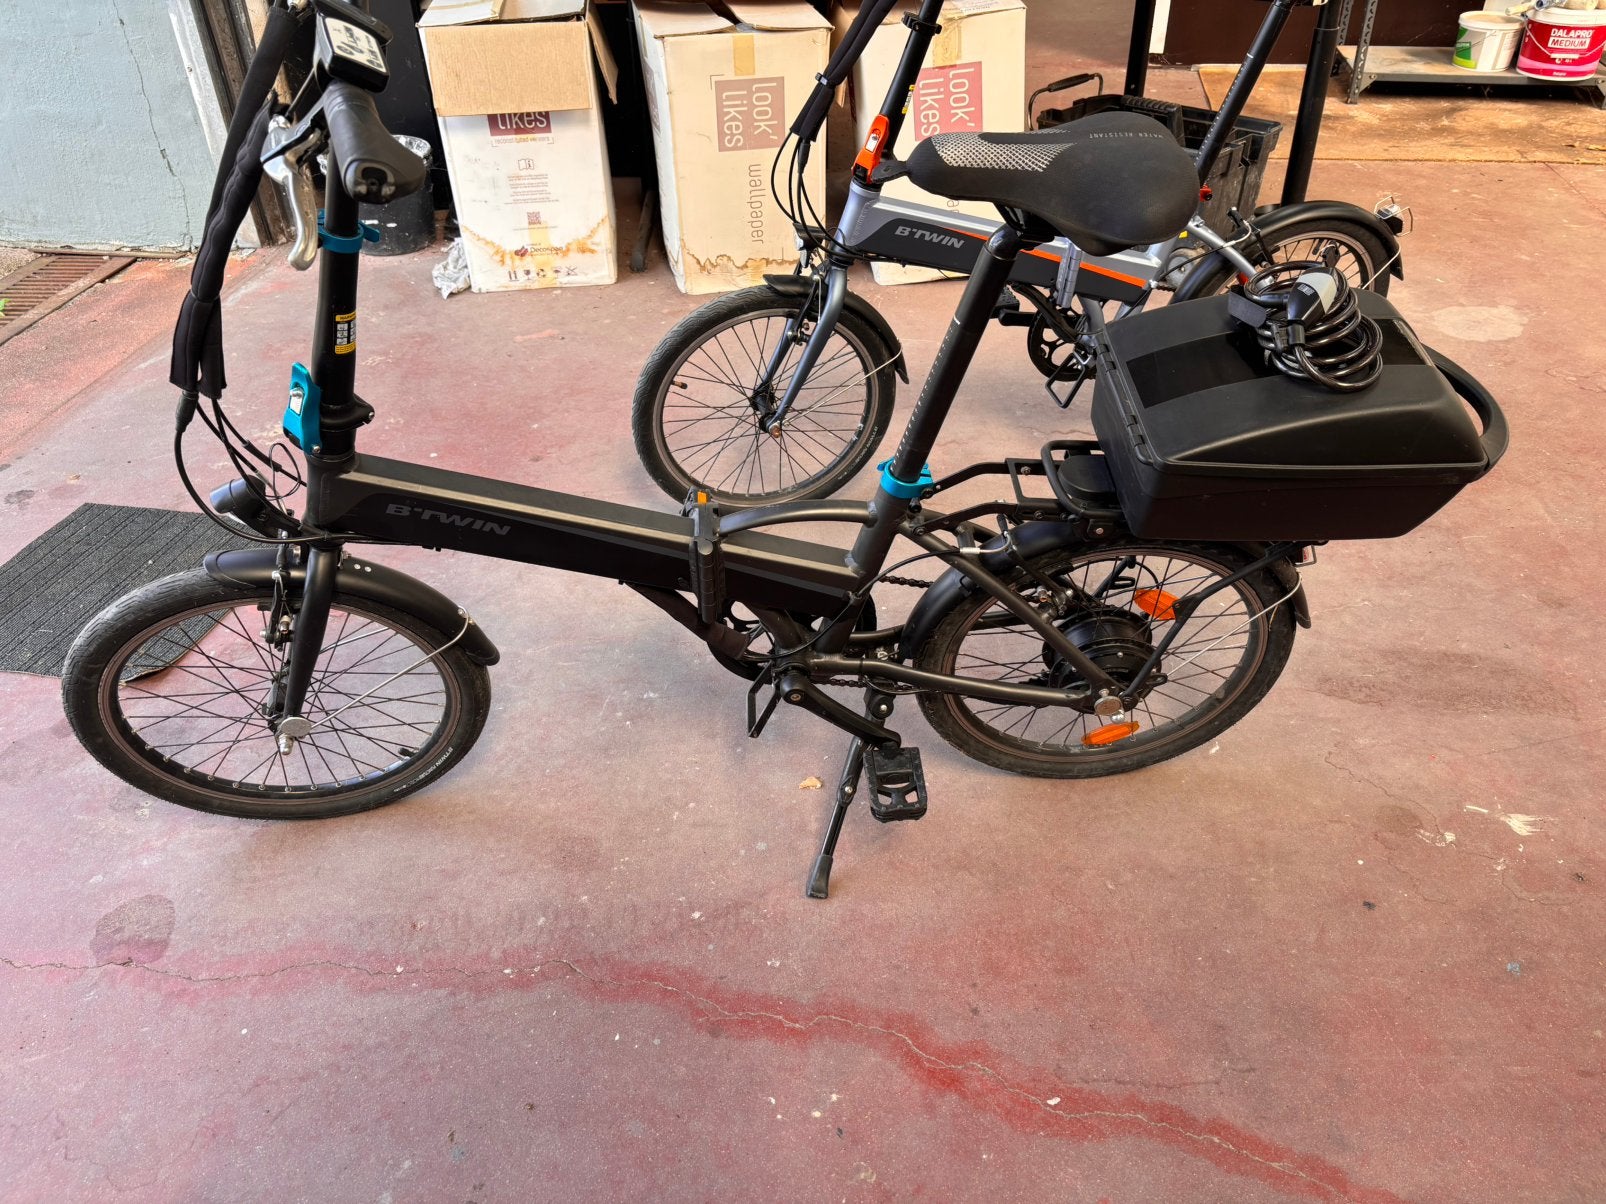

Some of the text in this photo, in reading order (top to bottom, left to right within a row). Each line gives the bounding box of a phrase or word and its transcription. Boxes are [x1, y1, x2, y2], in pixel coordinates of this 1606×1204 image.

[1550, 39, 1587, 48] MEDIUM
[1551, 28, 1593, 38] DALAPRO
[722, 90, 748, 148] likes
[919, 77, 945, 137] likes
[746, 163, 766, 244] wallpaper
